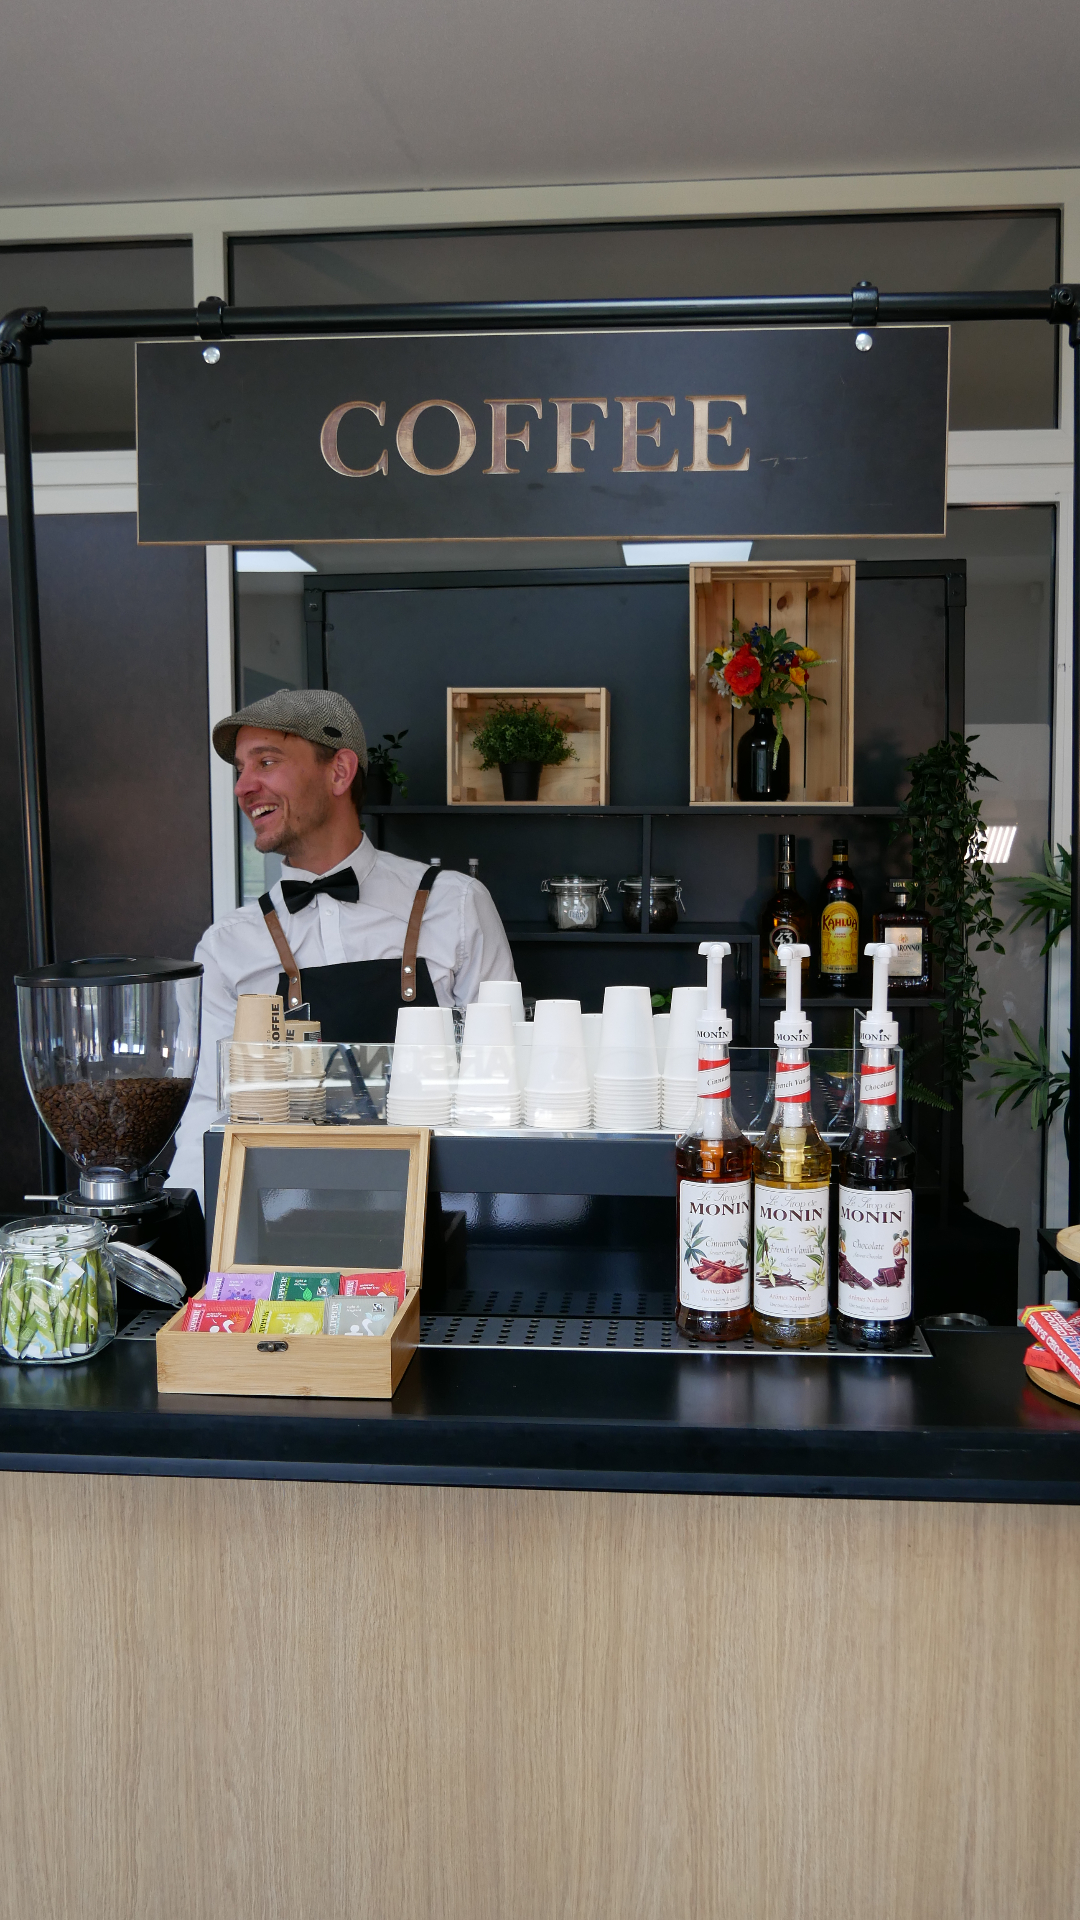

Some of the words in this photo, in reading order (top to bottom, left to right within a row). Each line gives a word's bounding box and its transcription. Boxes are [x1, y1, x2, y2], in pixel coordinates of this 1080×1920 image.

[320, 395, 750, 477] COFFEE
[822, 914, 858, 931] KAHLÚA
[774, 932, 793, 944] 43
[697, 1026, 729, 1039] MONIN
[776, 1029, 810, 1041] MONIN
[860, 1029, 891, 1041] MONIN
[864, 1079, 894, 1092] Chocolate
[697, 1190, 712, 1201] Le
[713, 1189, 736, 1203] Sirop
[766, 1194, 779, 1206] Le
[780, 1195, 804, 1209] Sirop
[844, 1195, 856, 1207] Le
[857, 1197, 883, 1211] Sirop
[885, 1201, 896, 1209] de
[689, 1201, 749, 1216] MONIN
[760, 1205, 823, 1222] MONIN
[840, 1205, 903, 1224] MONIN
[705, 1237, 739, 1248] Cinnamon
[852, 1238, 885, 1251] Chocolate
[1040, 1311, 1068, 1336] CHOCO
